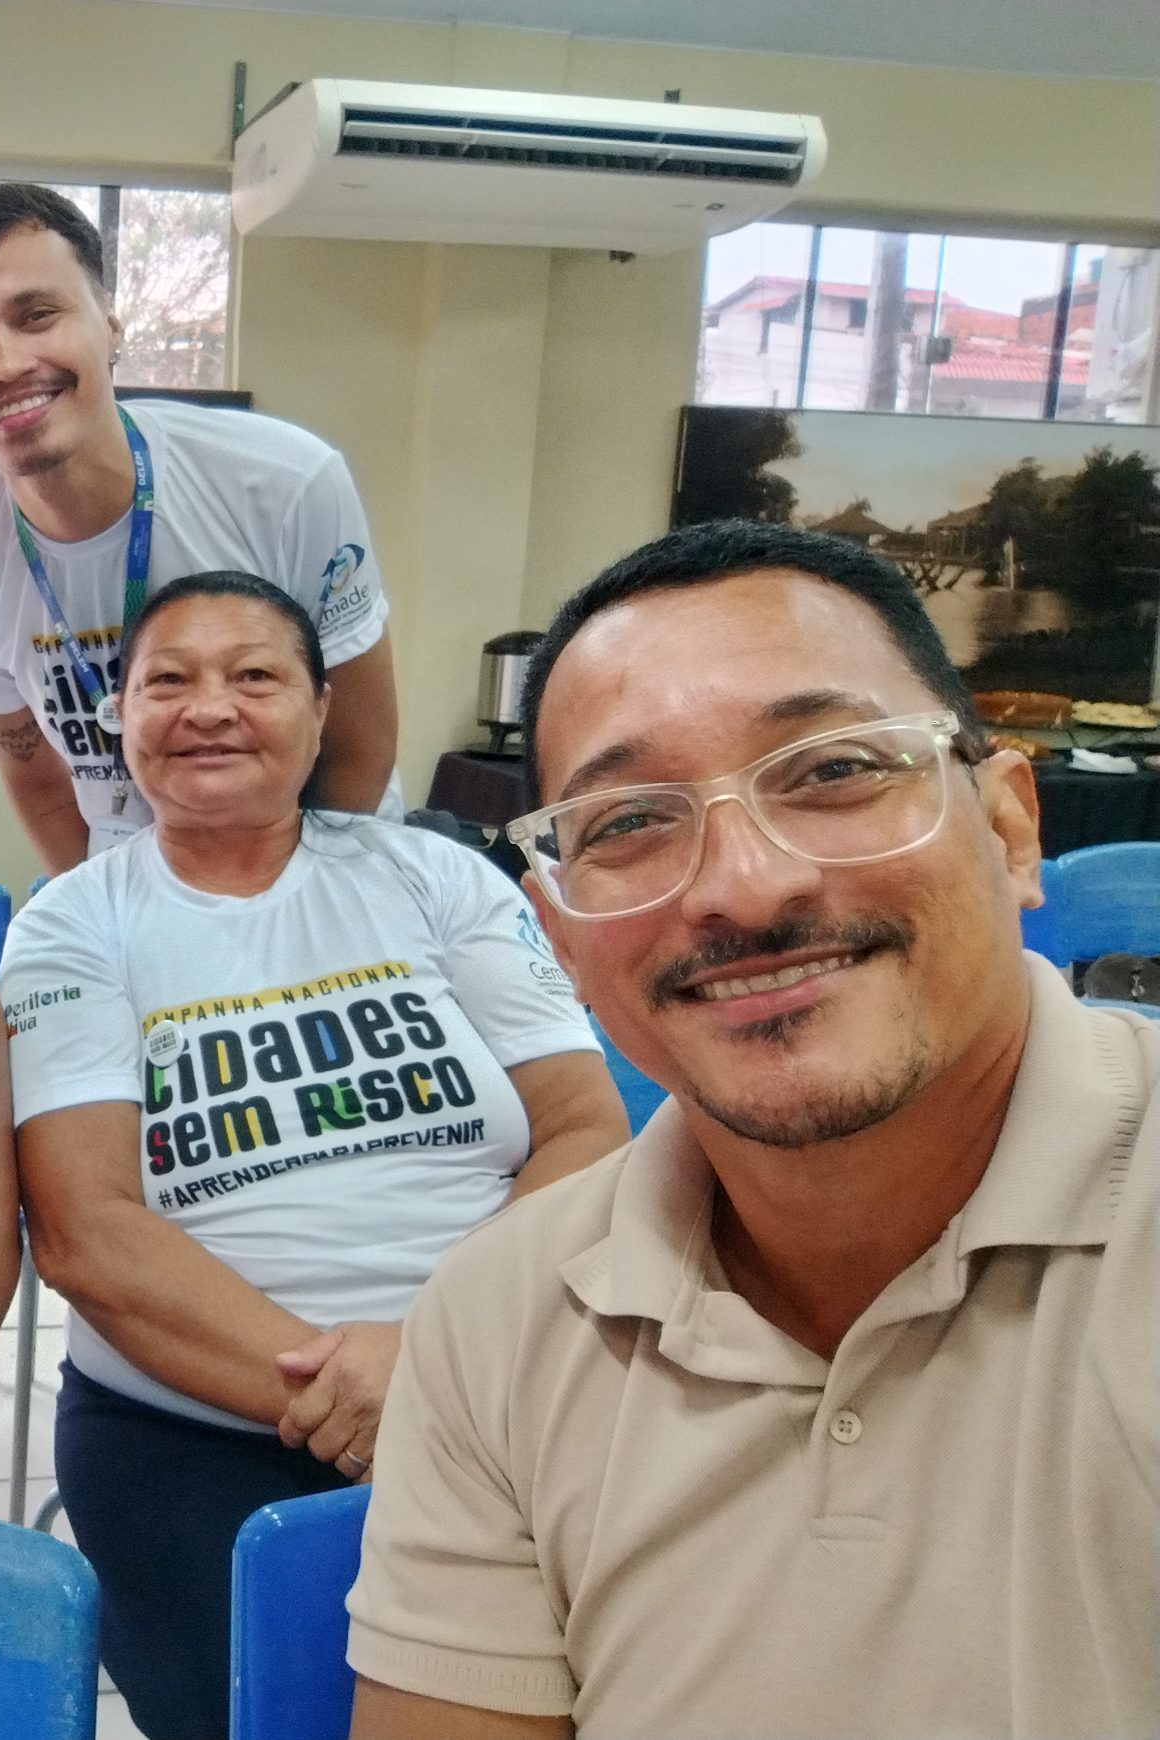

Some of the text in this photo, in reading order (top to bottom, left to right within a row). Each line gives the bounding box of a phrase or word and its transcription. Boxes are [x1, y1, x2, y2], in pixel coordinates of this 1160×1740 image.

[4, 984, 81, 1023] periferia
[280, 962, 412, 1005] NACIONAL
[146, 1095, 281, 1176] sem
